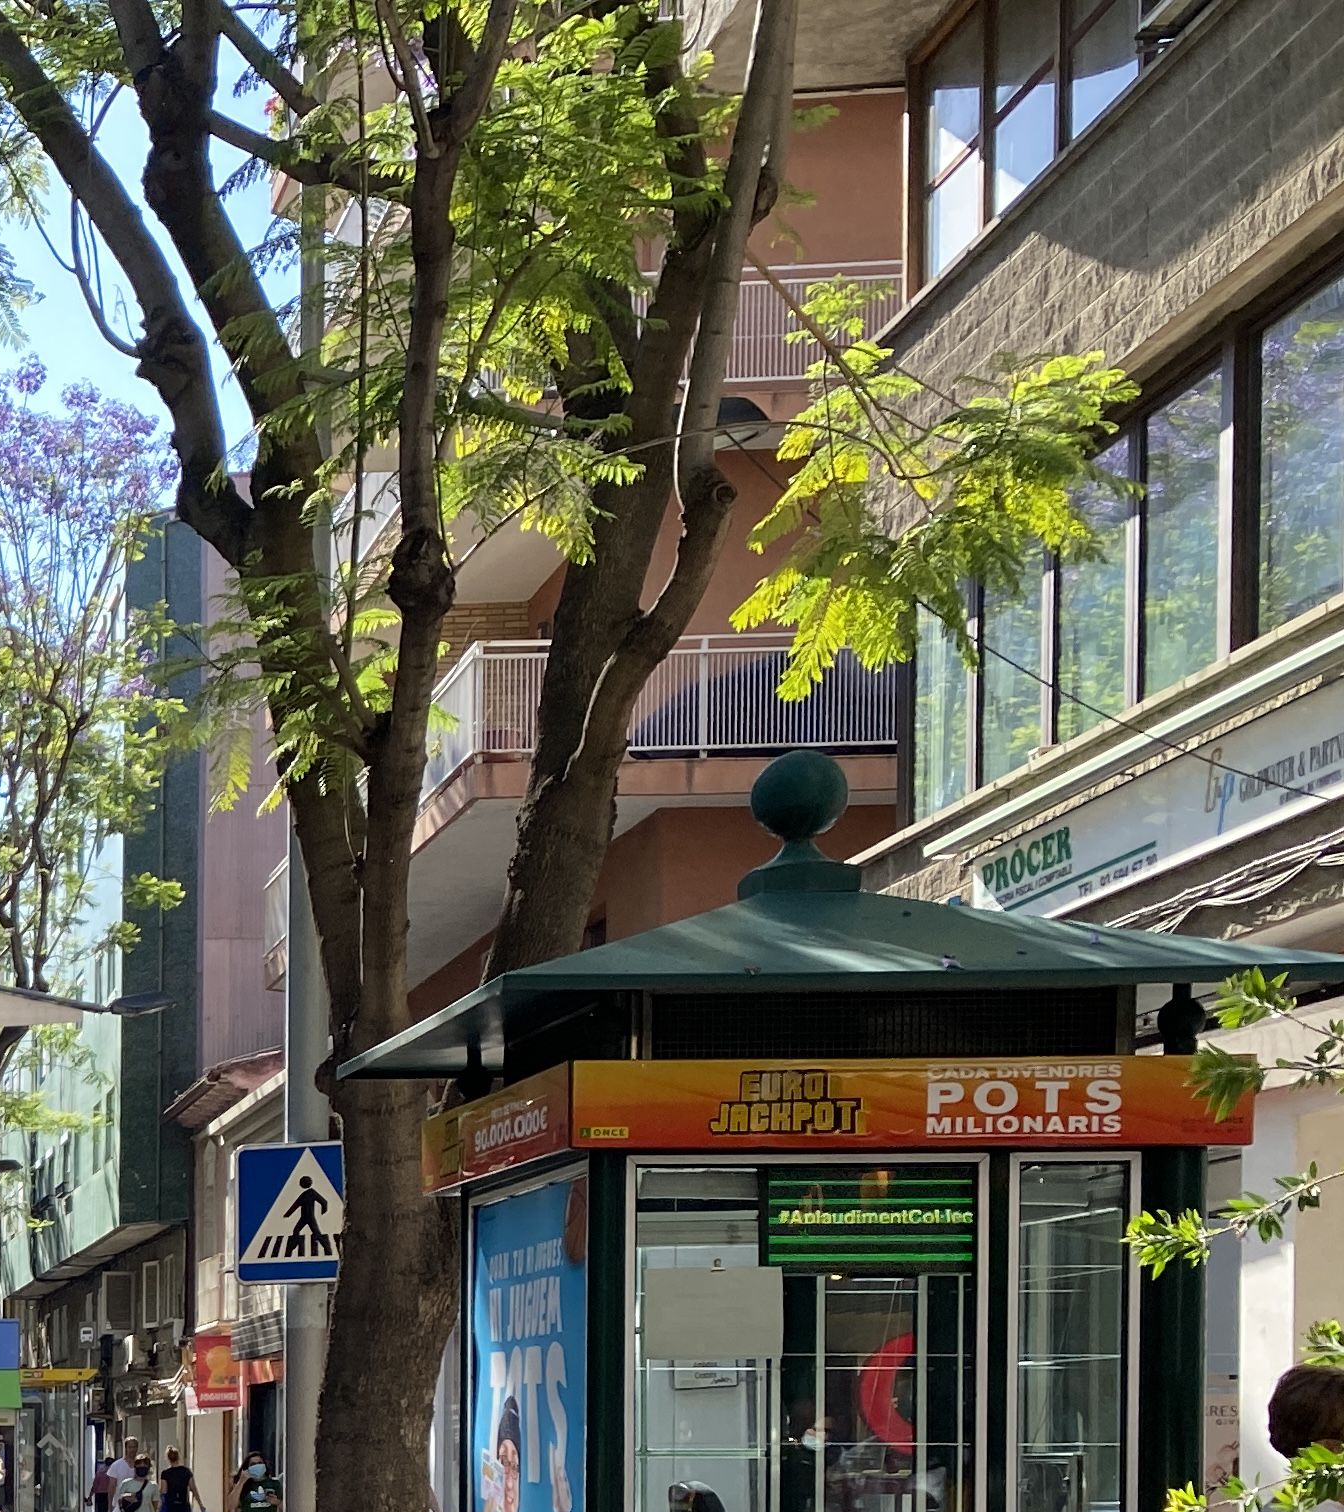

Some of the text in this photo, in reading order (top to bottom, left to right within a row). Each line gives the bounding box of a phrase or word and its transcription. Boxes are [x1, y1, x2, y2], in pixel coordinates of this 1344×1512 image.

[742, 1071, 825, 1101] EURO
[927, 1064, 1122, 1080] CADA DIVENDRES
[927, 1080, 1122, 1115] POTS
[474, 1106, 548, 1153] 90.000.000€
[711, 1101, 858, 1133] JACKPOT
[926, 1115, 1122, 1135] MILIONARIS
[593, 1129, 626, 1137] ONCE
[513, 1248, 525, 1277] TU
[489, 1275, 562, 1344] HI JUGUEM
